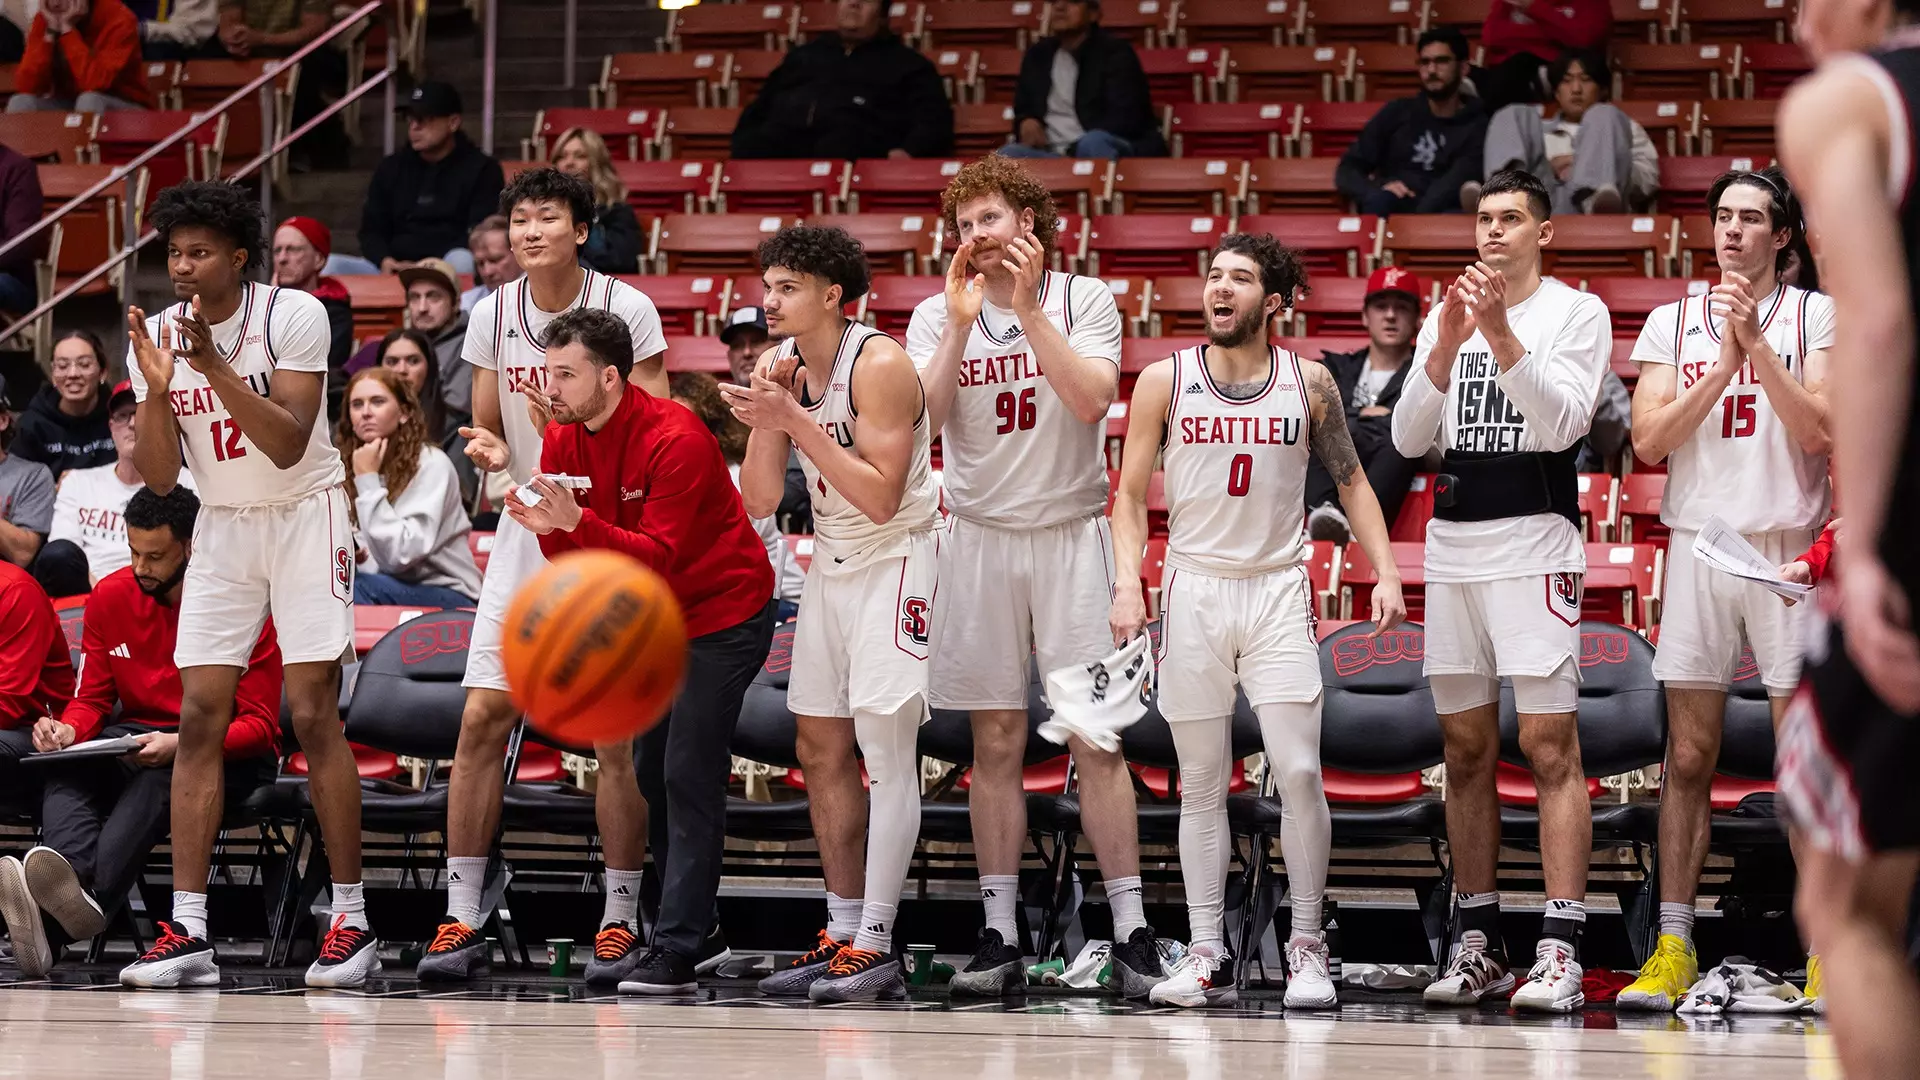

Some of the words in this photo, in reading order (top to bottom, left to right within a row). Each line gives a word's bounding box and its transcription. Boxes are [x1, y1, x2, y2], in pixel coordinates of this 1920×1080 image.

[958, 353, 1044, 387] SEATTL
[1460, 352, 1488, 379] THIS
[995, 387, 1037, 435] 96
[1180, 416, 1301, 446] SEATTLEU
[1721, 394, 1757, 439] 15
[210, 417, 247, 462] 12
[1227, 453, 1254, 497] 0
